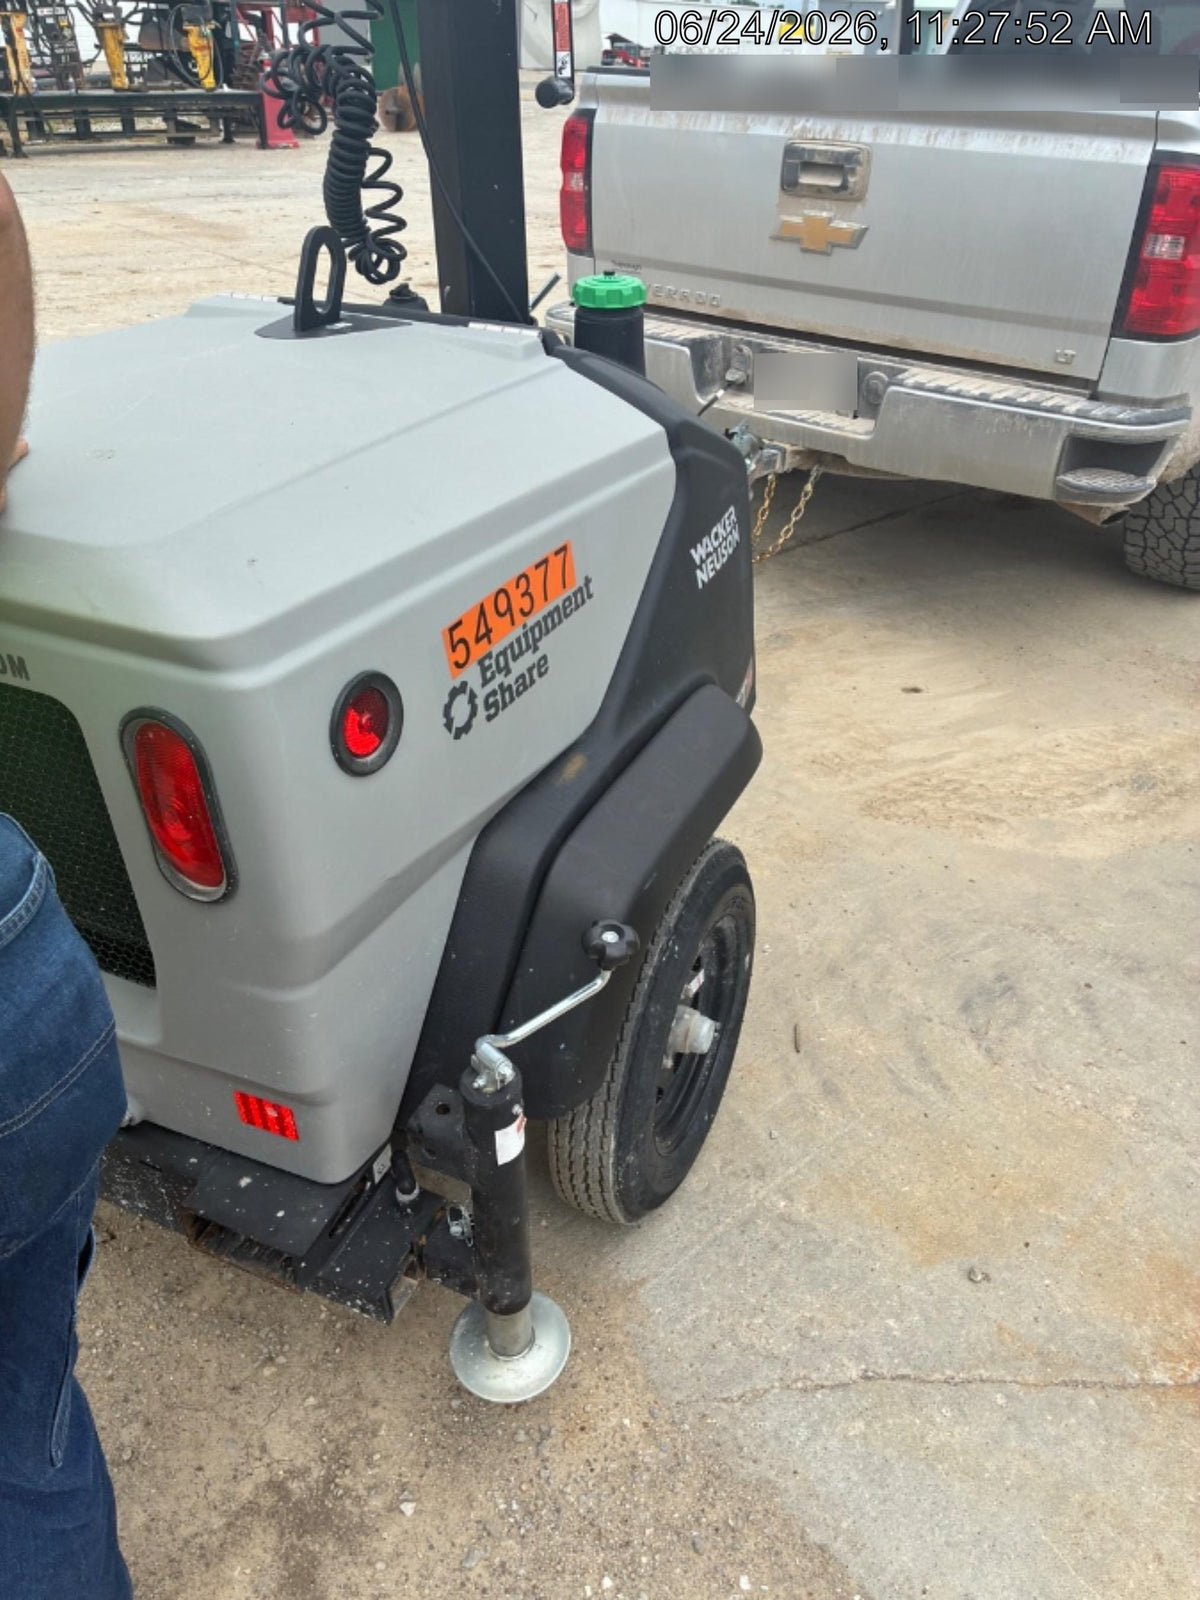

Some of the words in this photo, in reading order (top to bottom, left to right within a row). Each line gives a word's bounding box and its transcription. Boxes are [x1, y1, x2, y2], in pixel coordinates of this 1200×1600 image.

[690, 505, 737, 566] WACKER
[696, 523, 740, 590] NEUSON
[448, 543, 569, 669] 549377
[477, 575, 594, 688] Equipment
[483, 653, 549, 722] Share
